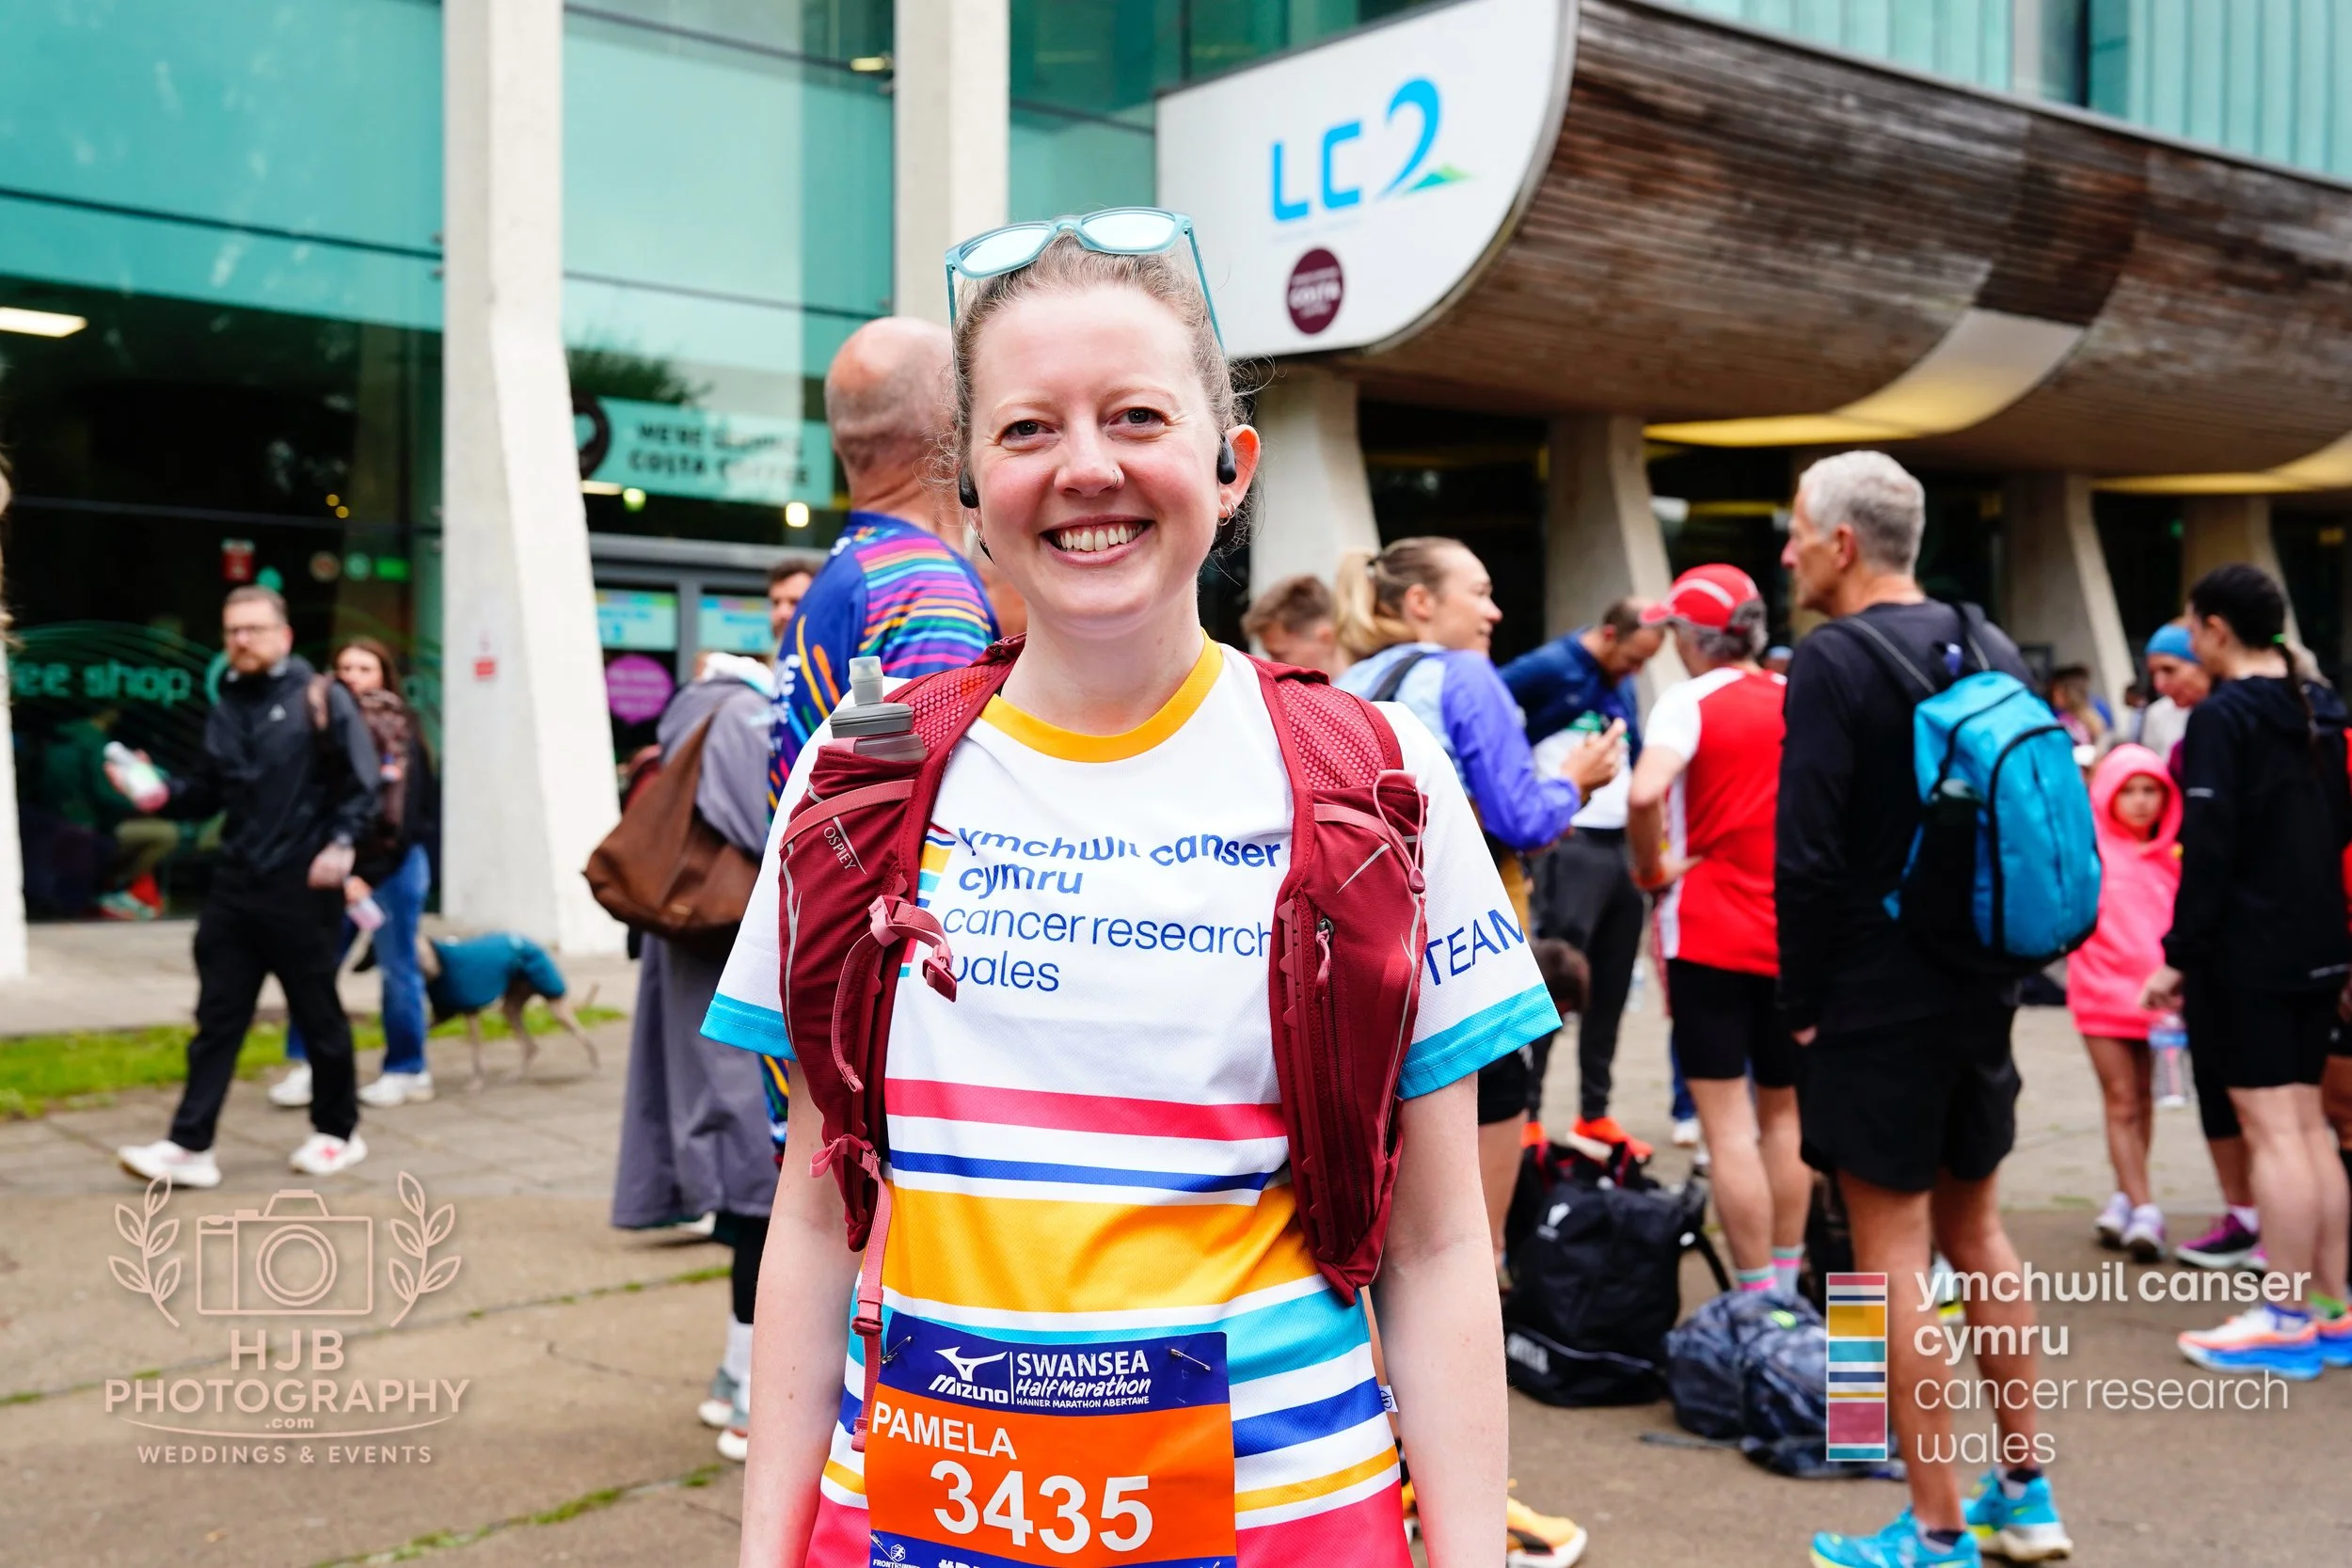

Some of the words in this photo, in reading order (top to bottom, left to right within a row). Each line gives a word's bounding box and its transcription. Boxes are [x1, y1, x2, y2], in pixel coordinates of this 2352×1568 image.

[1273, 77, 1440, 221] LC2
[84, 659, 191, 707] shop
[1149, 833, 1281, 867] canser
[959, 863, 1083, 899] cymru
[943, 908, 1086, 943] cancer
[1424, 909, 1525, 986] TEAM
[1017, 1349, 1150, 1378] SWANSEA
[1016, 1397, 1051, 1408] HANNER
[1052, 1399, 1101, 1408] MARATHON
[1103, 1396, 1150, 1408] ABERTAWE
[872, 1401, 1018, 1461] PAMELA
[930, 1460, 1153, 1554] 3435
